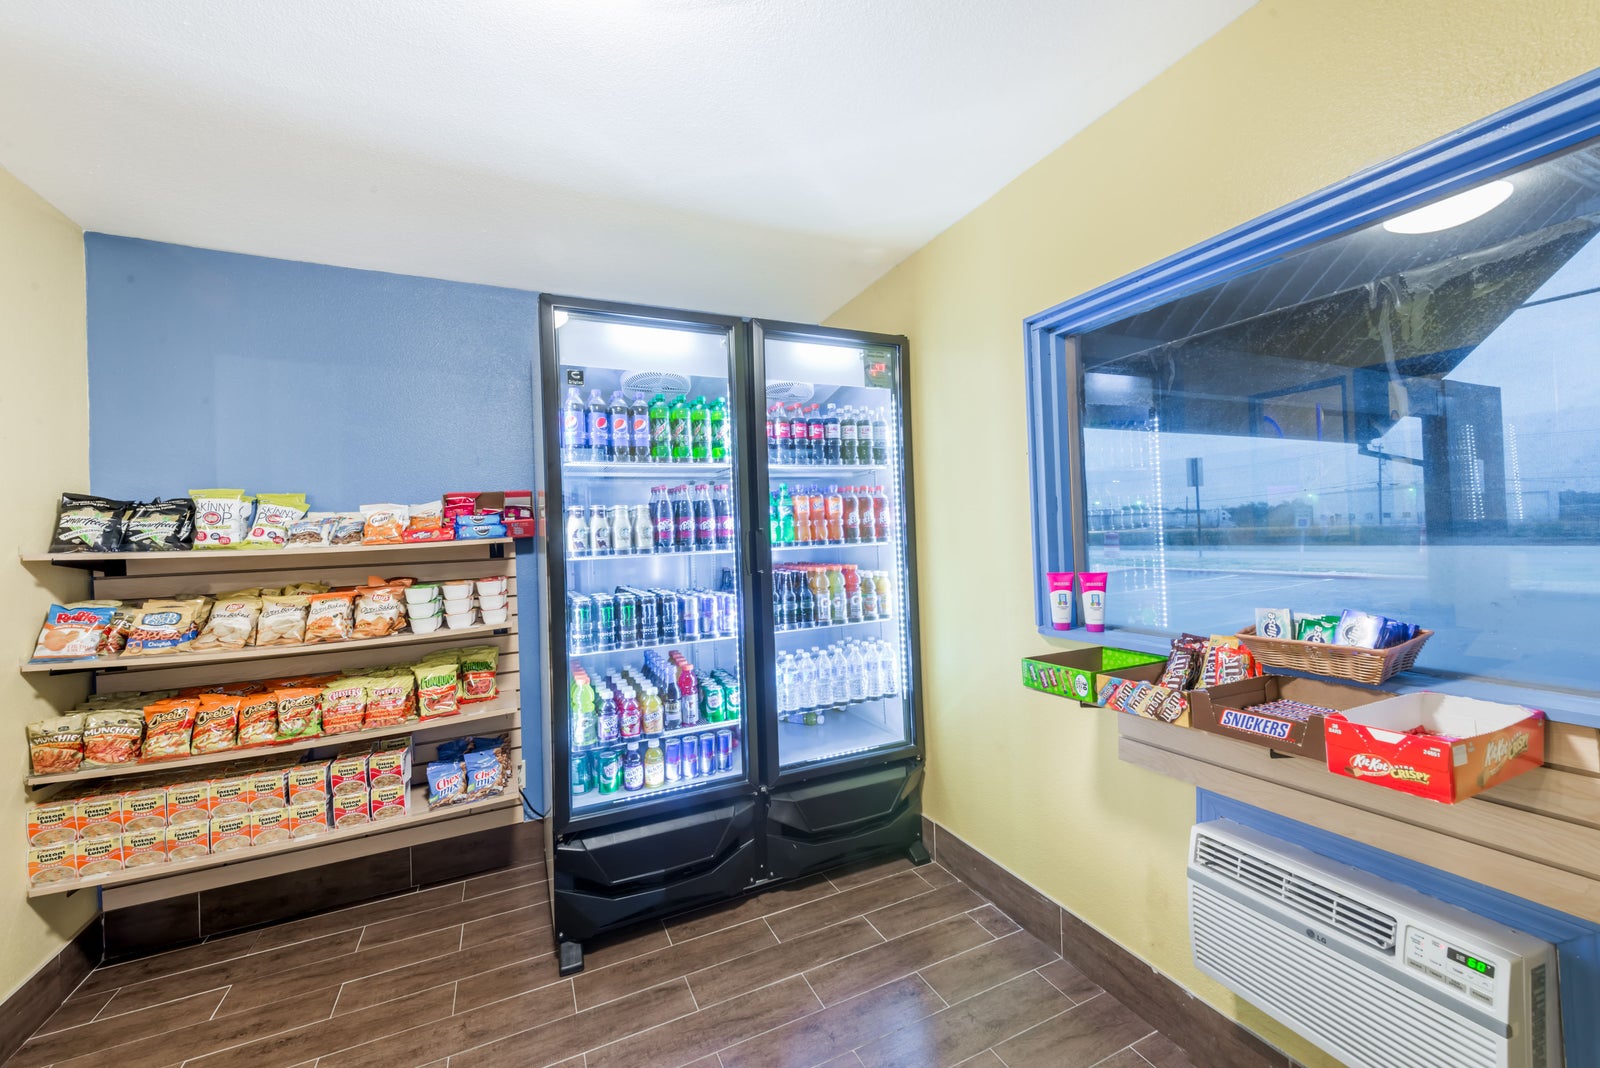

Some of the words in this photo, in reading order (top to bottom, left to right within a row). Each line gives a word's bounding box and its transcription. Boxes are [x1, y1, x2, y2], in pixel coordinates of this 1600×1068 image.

[195, 511, 233, 525] POP
[262, 506, 297, 520] SKINNY
[243, 701, 277, 718] Cheetos
[279, 696, 315, 713] Cheetos
[149, 708, 188, 726] Cheetos
[198, 706, 233, 725] Cheetos
[1223, 710, 1290, 738] SNICKERS
[84, 727, 140, 737] MUNCHIES
[436, 773, 460, 791] Chex
[1390, 768, 1430, 783] CRISPY
[37, 813, 66, 821] Instant
[85, 807, 112, 815] Instant
[175, 830, 200, 838] Instant
[37, 851, 66, 859] Instant
[85, 844, 112, 853] Instant
[1316, 935, 1327, 945] LG
